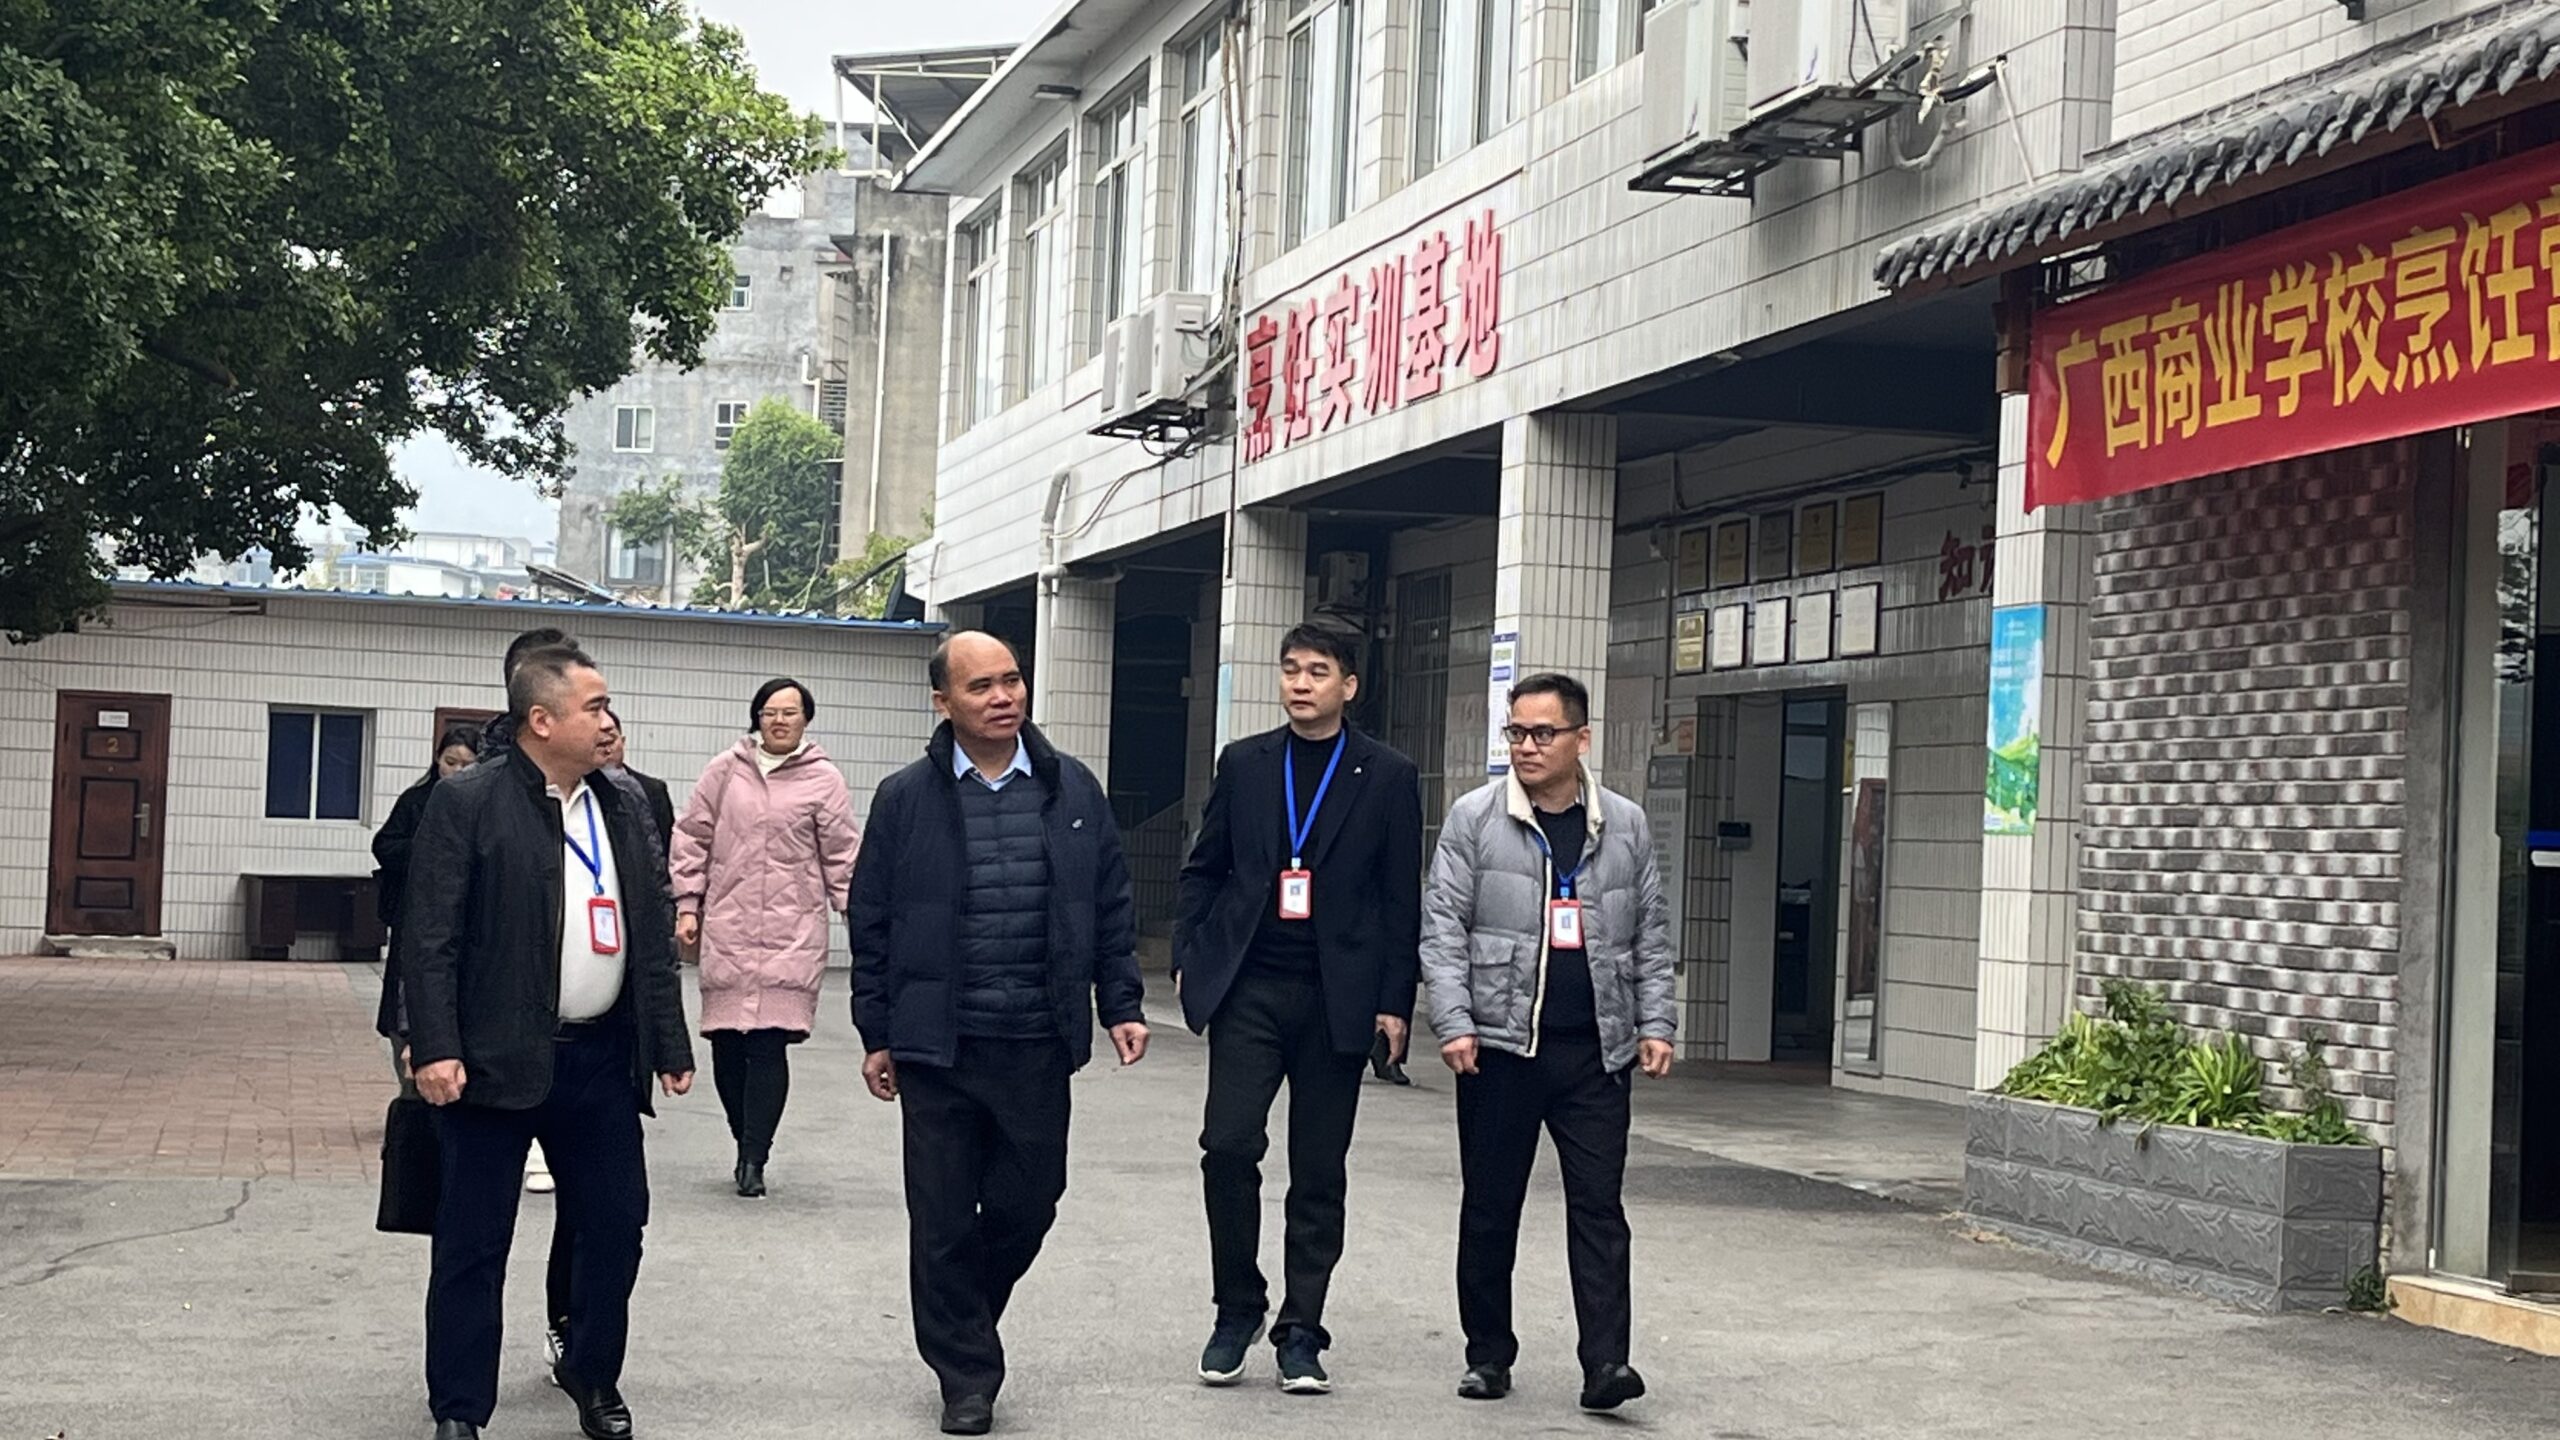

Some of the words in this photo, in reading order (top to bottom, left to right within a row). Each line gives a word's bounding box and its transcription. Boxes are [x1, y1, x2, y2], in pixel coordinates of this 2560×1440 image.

[1244, 208, 1502, 464] 烹饪实训基地
[107, 736, 119, 753] 2
